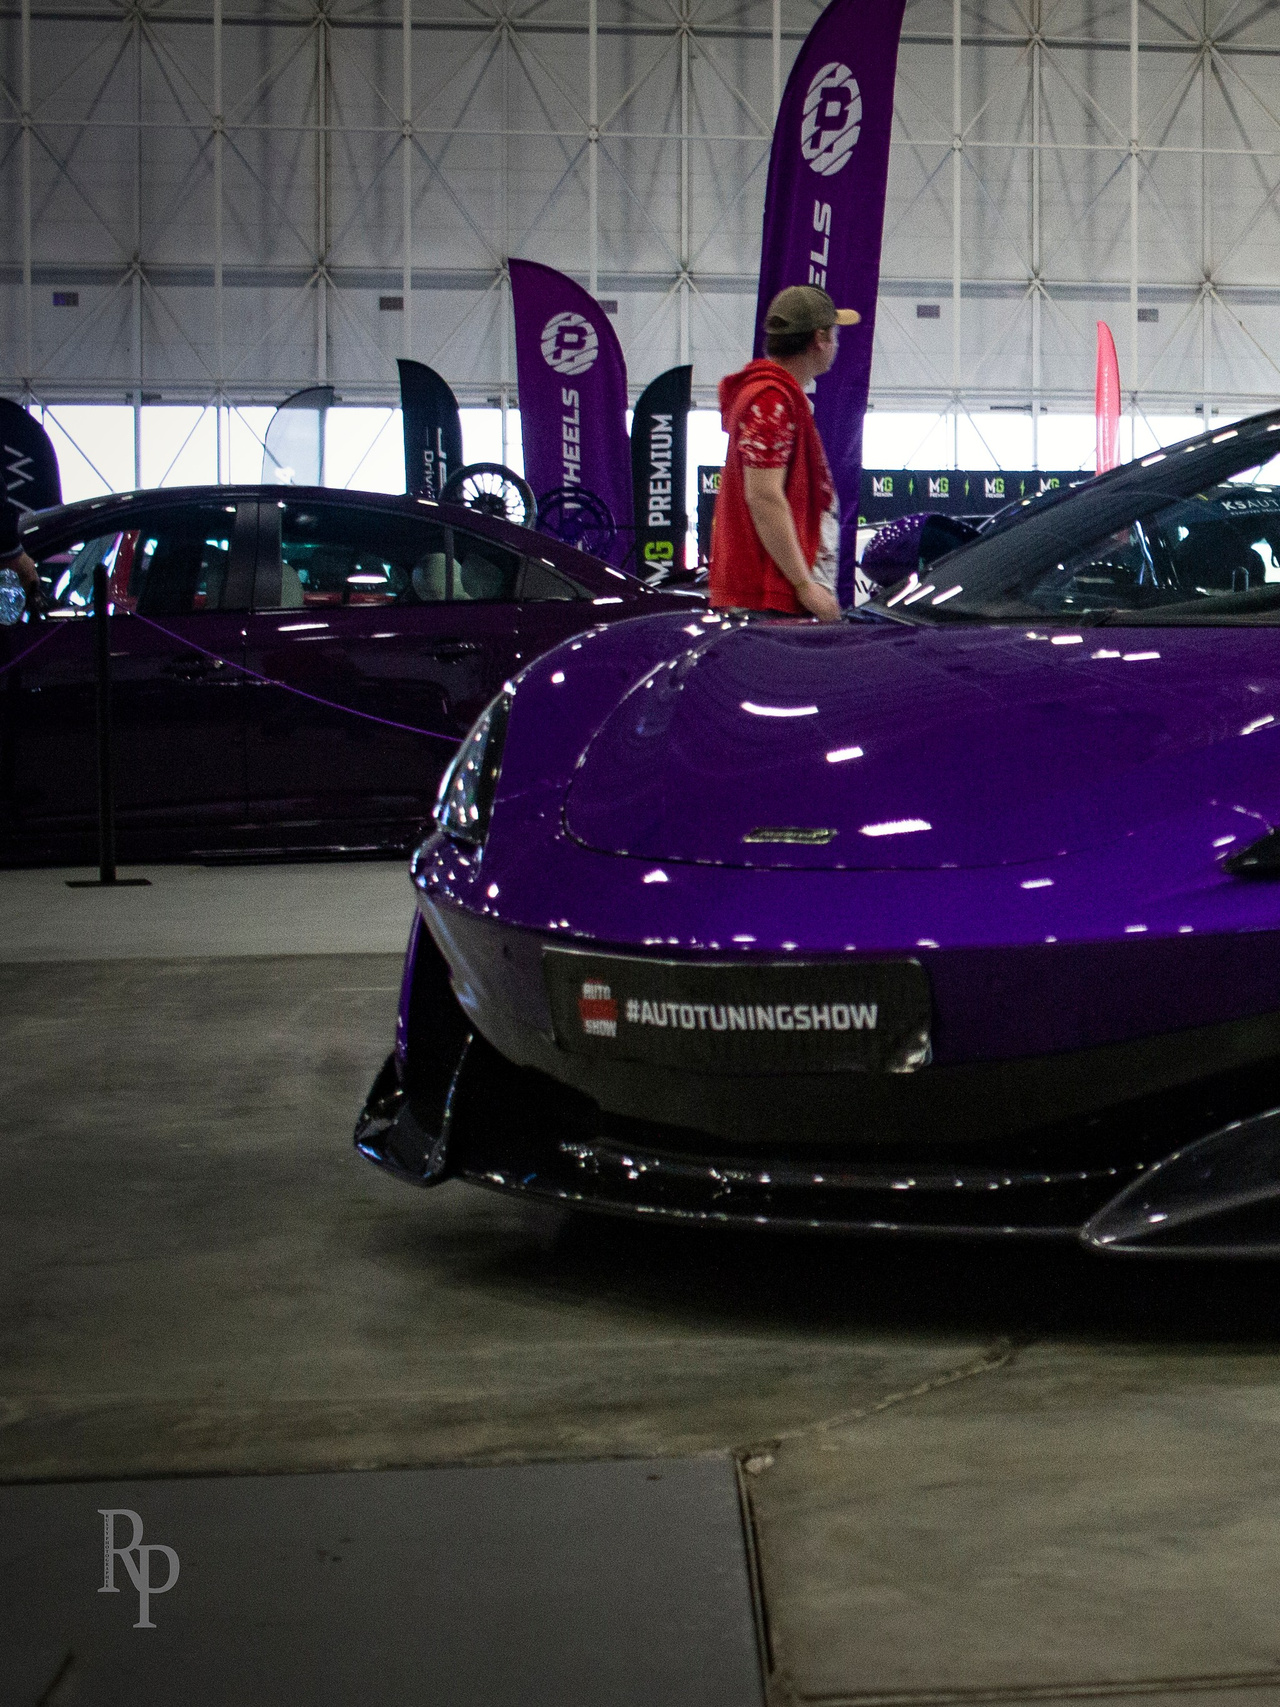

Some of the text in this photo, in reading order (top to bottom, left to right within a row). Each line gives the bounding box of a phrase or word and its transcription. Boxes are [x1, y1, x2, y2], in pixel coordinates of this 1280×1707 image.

[648, 414, 673, 527] PREMIUM
[873, 476, 893, 492] MG
[929, 477, 950, 493] MG
[984, 477, 1005, 494] MG
[625, 999, 878, 1031] #AUTOTUNINGSHOW
